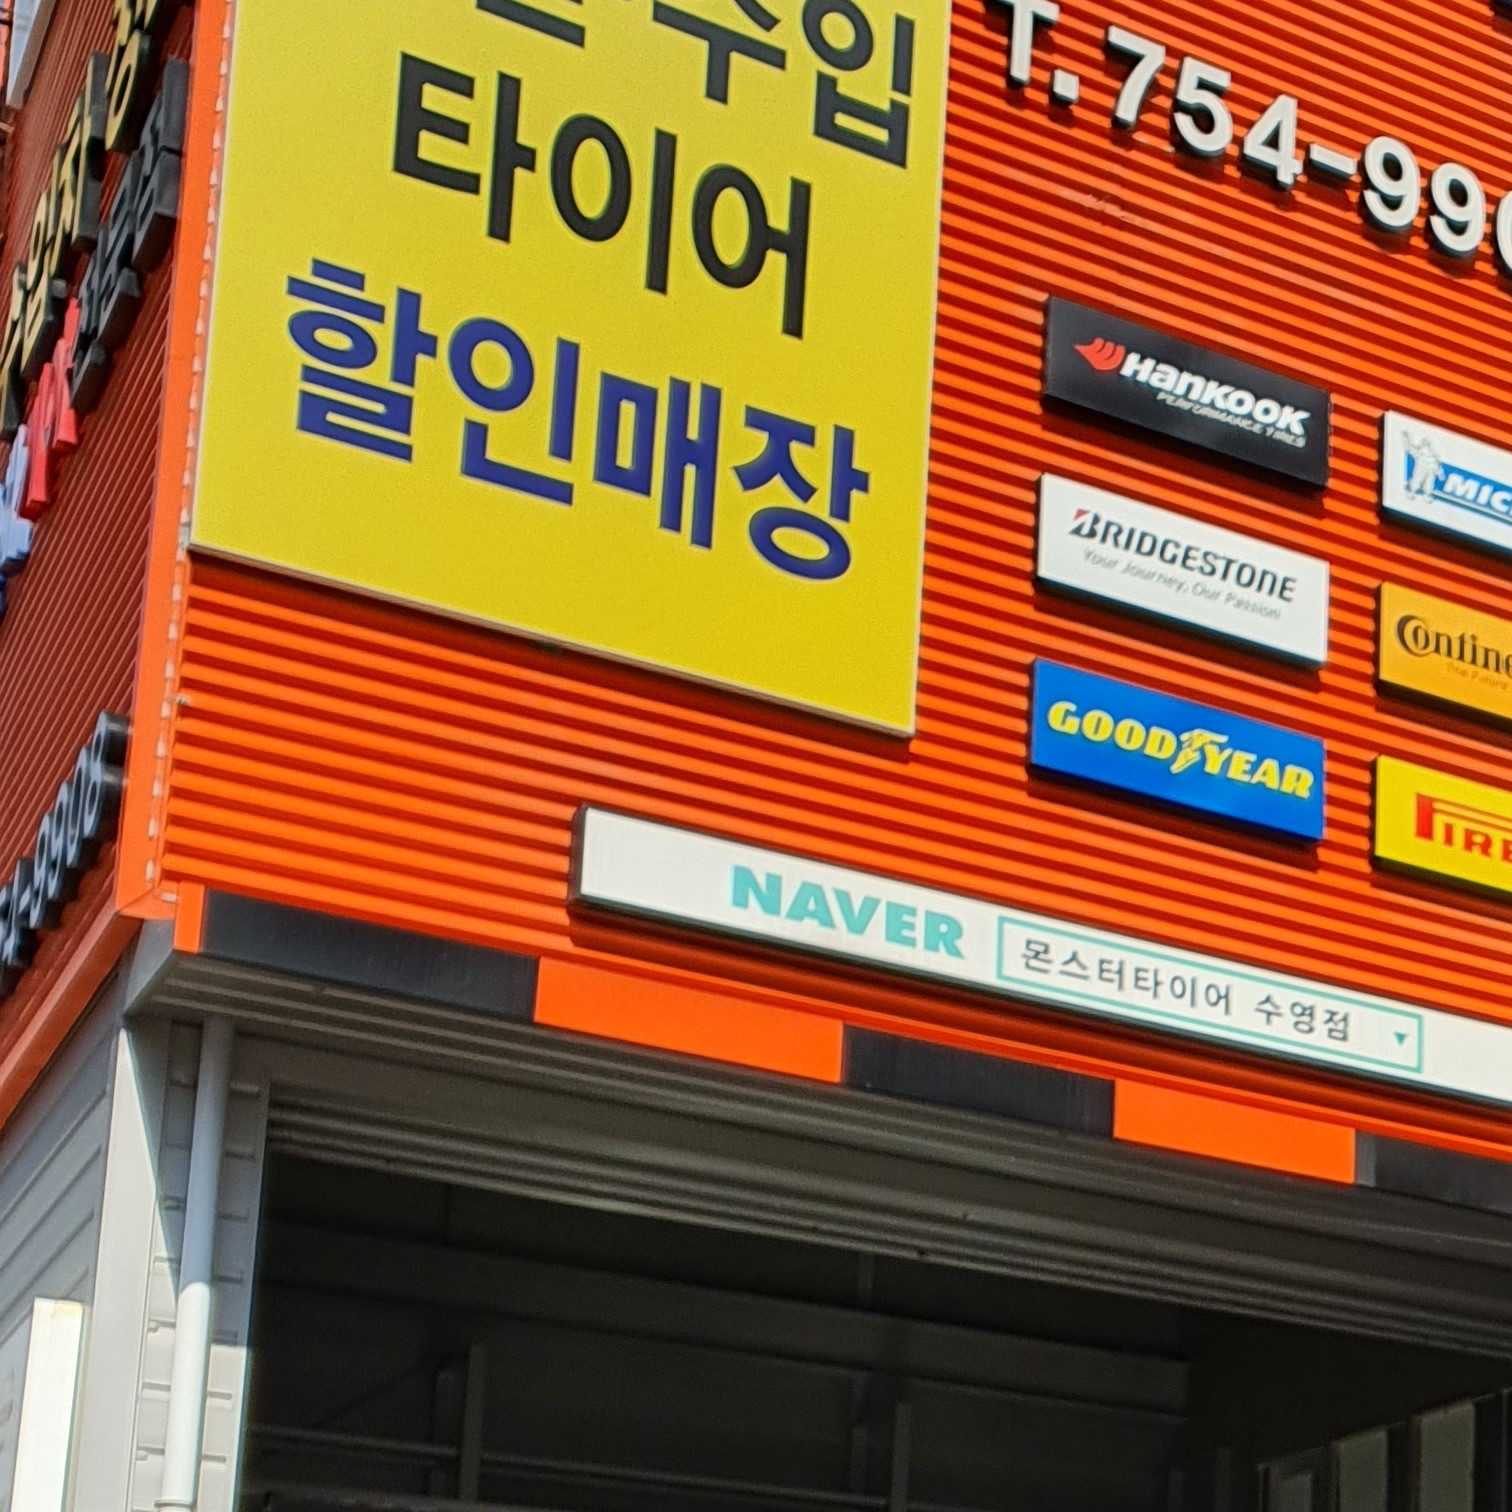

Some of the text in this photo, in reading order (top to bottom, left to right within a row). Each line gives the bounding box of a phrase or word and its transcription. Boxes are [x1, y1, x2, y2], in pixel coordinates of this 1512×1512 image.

[392, 51, 811, 338] 타이어
[286, 258, 870, 582] 할인매장
[1068, 508, 1298, 603] BRIDGESTONE
[1047, 700, 1315, 800] GOODYEAR
[731, 864, 966, 961] NAVER
[1020, 938, 1351, 1043] 몬스터타이어 수영점
